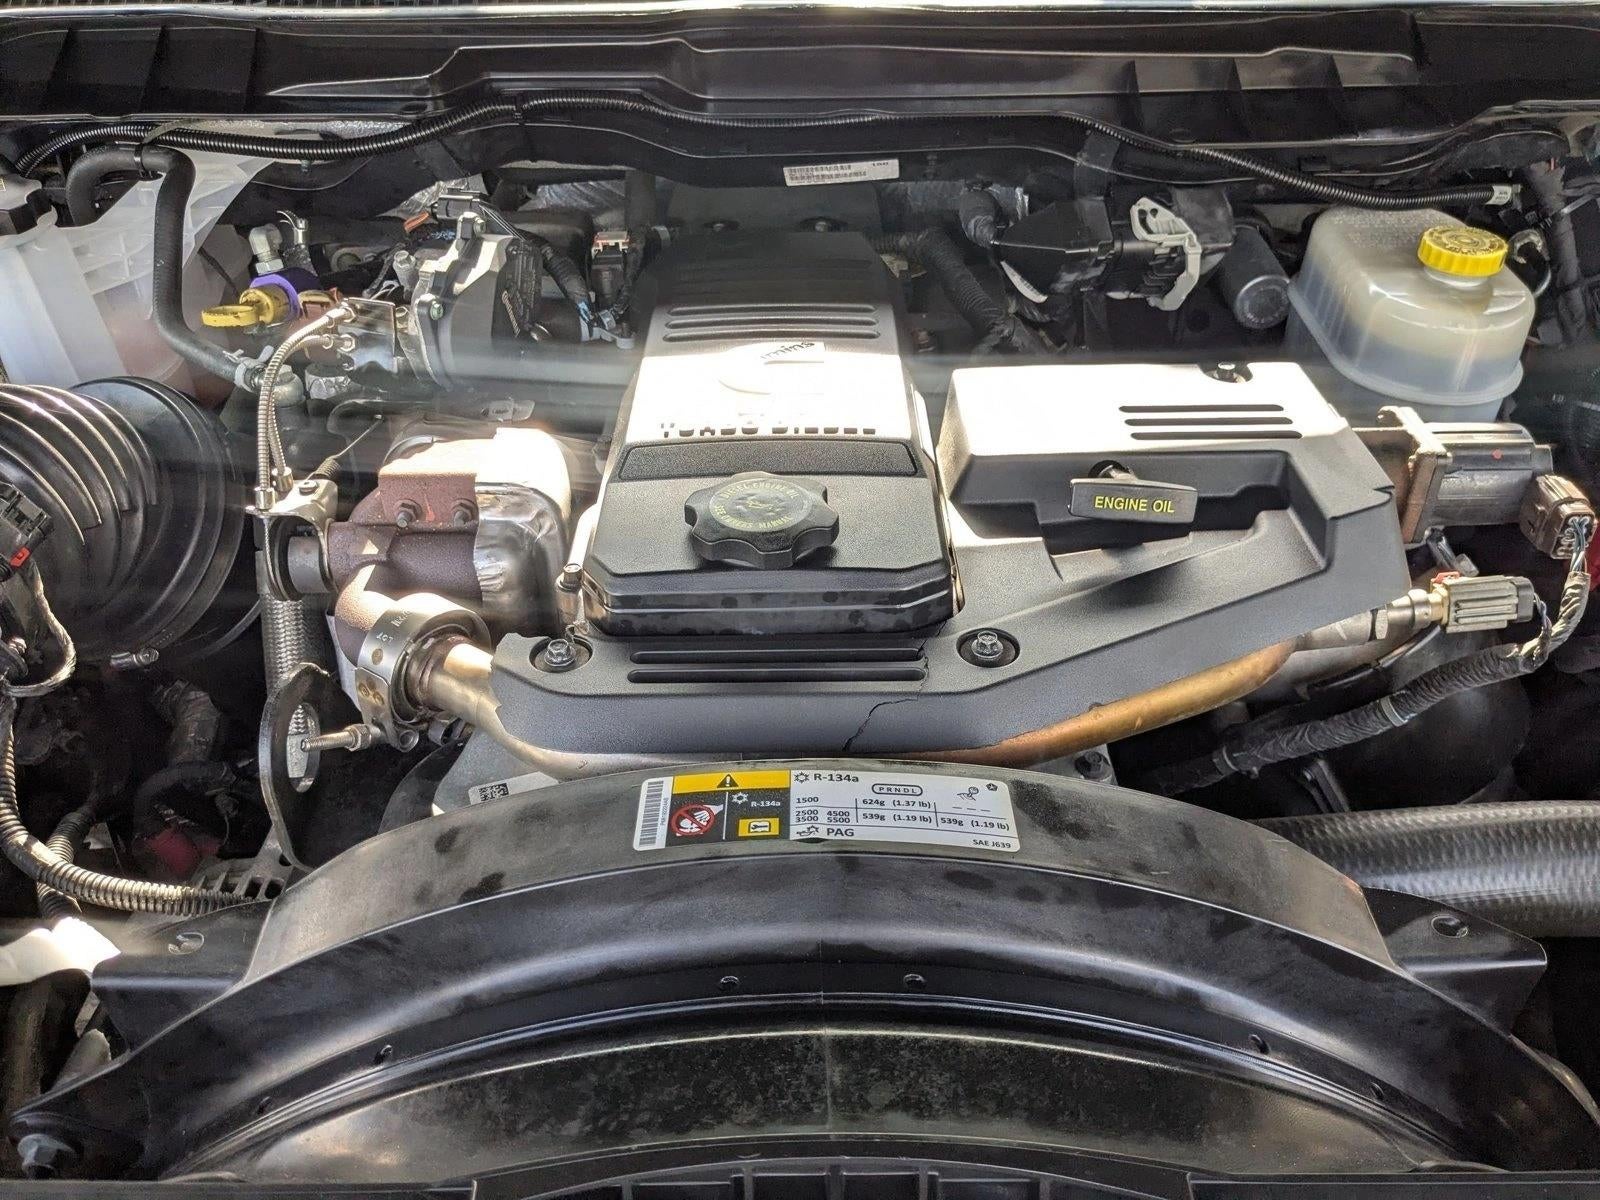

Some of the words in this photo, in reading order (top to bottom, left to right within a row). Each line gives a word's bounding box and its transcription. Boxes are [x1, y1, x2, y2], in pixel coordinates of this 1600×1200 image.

[1094, 496, 1148, 511] ENGINE
[1153, 499, 1175, 513] OIL
[813, 773, 859, 783] R-134a
[796, 796, 819, 804] 1500
[862, 798, 886, 807] 624g
[892, 799, 916, 808] (1.37
[918, 800, 931, 809] lb)
[795, 809, 819, 817] 2500
[795, 815, 819, 823] 3500
[826, 816, 851, 824] 5500
[862, 813, 886, 821] 539g
[892, 813, 917, 822] (1.19
[919, 815, 932, 824] lb)
[940, 817, 964, 827] 539g
[970, 819, 995, 829] (1.19
[997, 821, 1010, 831] lb)
[826, 827, 855, 837] PAG
[972, 839, 990, 847] SAE
[991, 841, 1012, 849] J639
